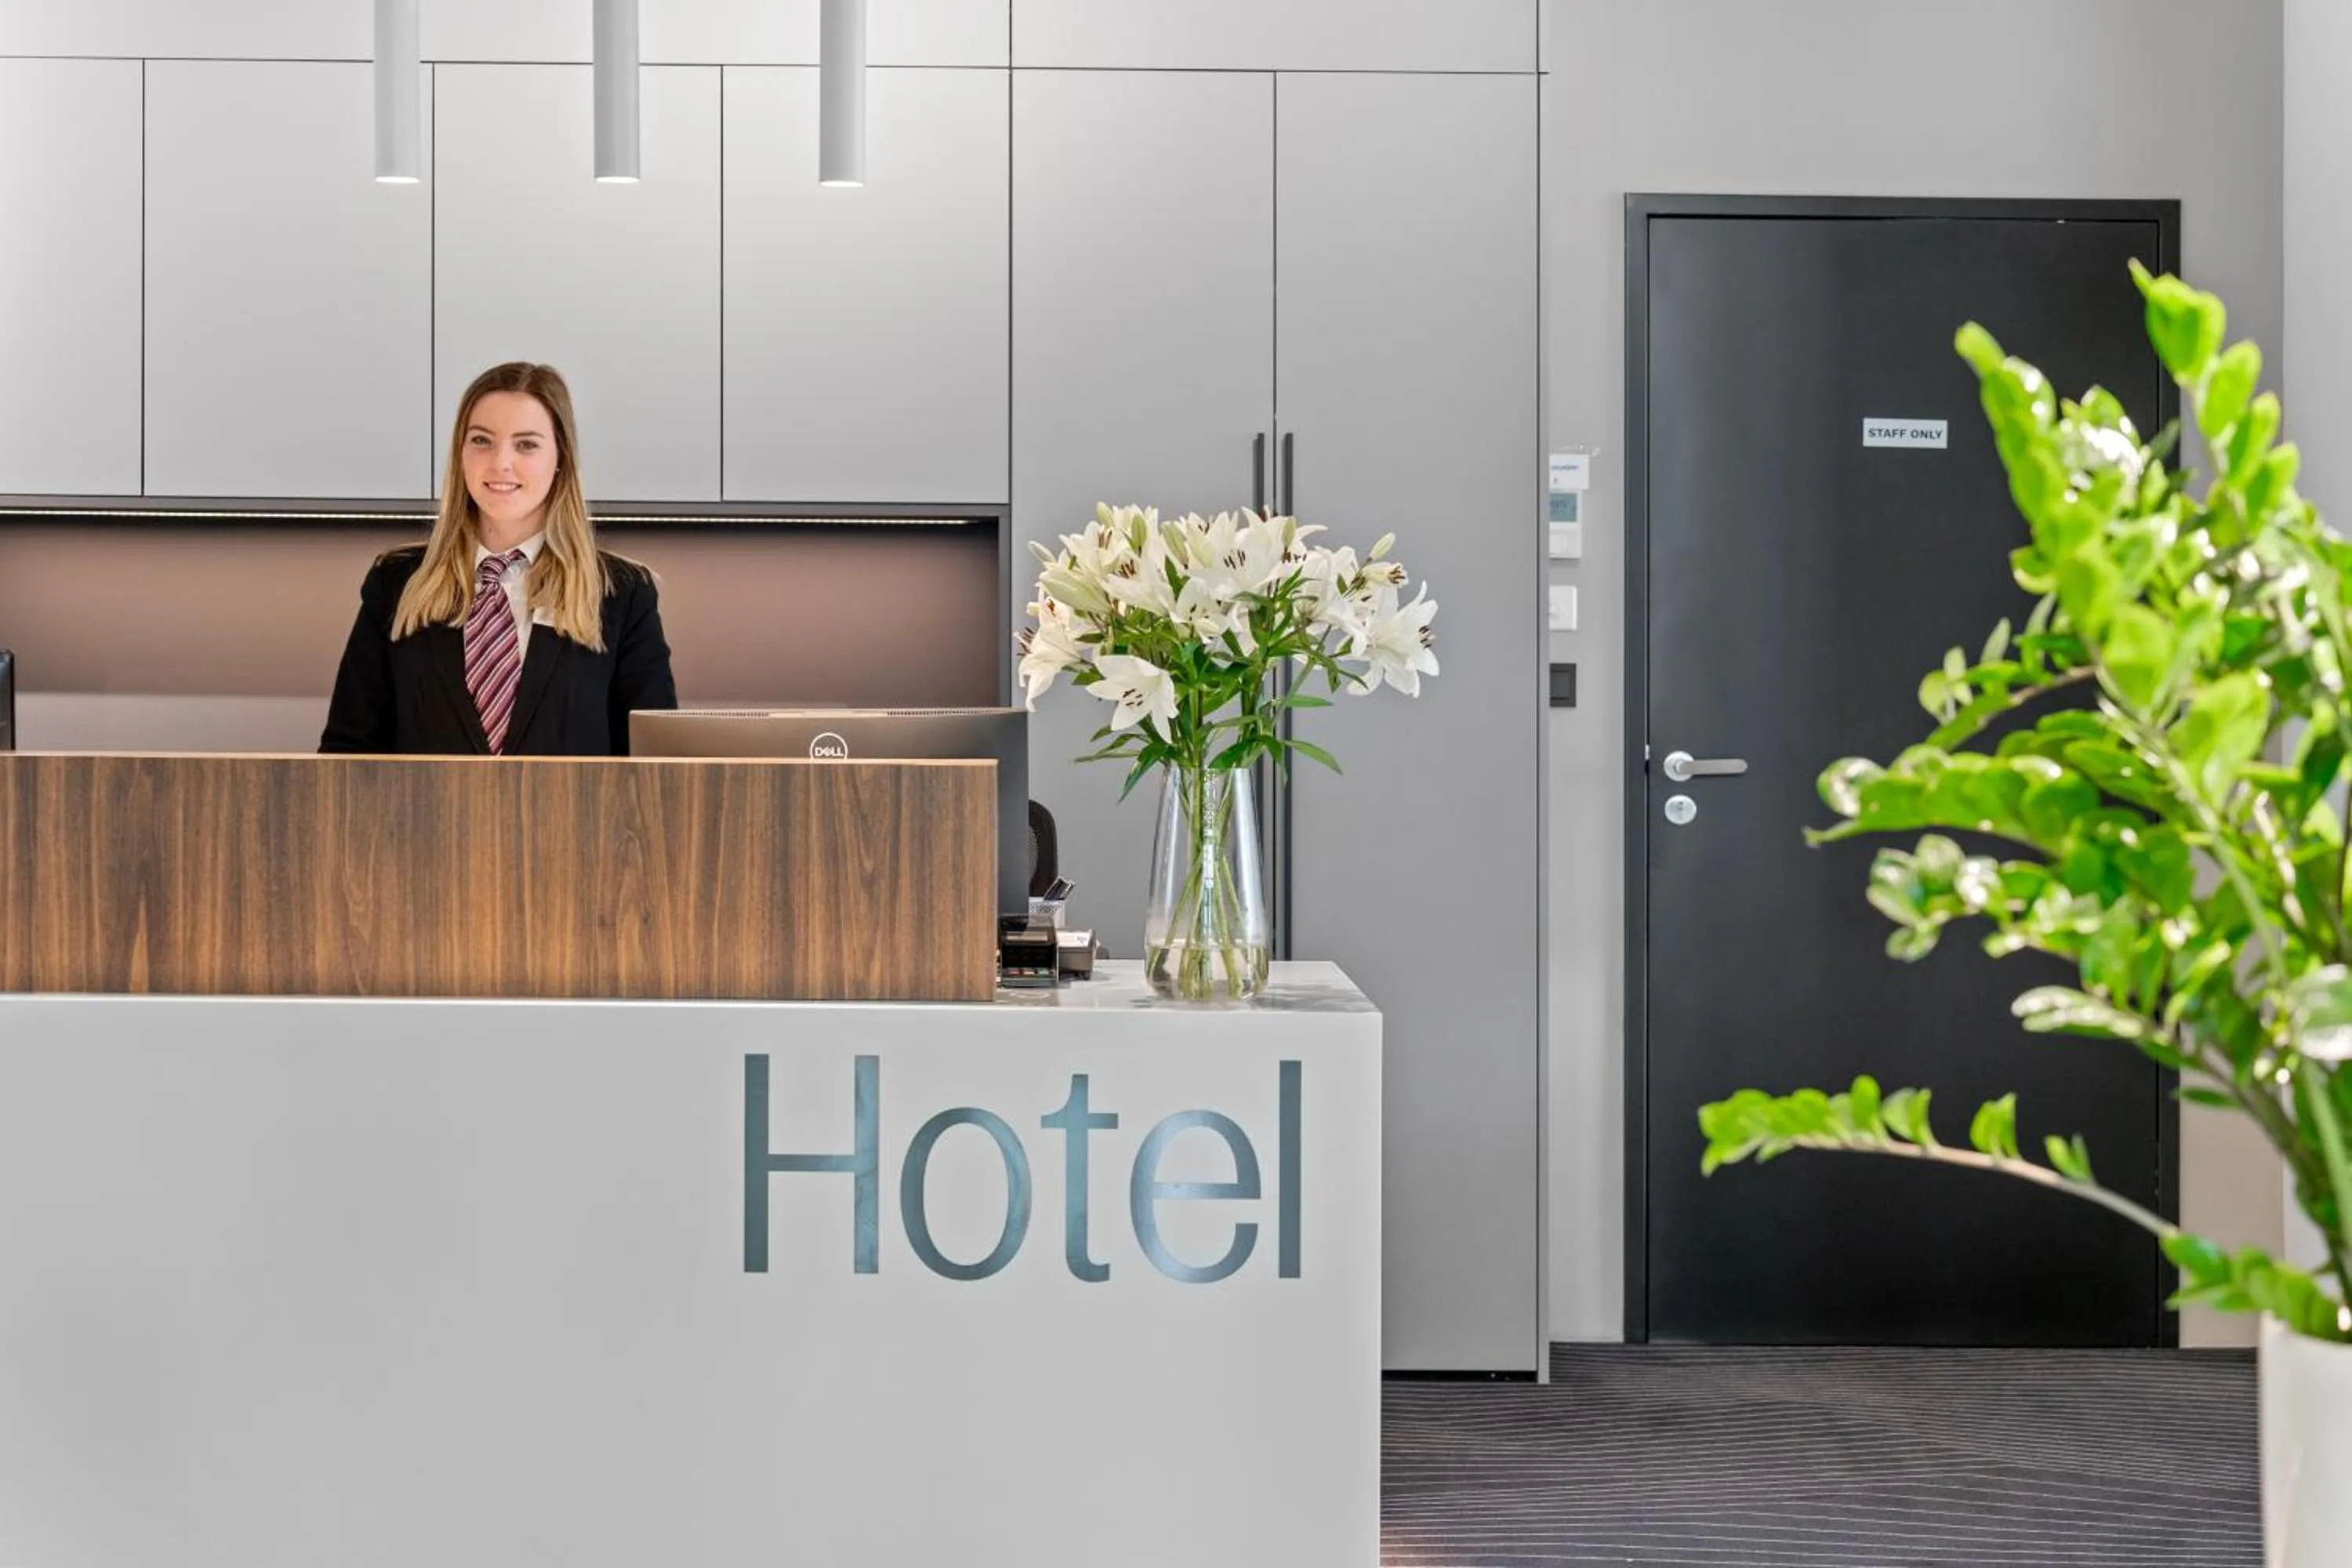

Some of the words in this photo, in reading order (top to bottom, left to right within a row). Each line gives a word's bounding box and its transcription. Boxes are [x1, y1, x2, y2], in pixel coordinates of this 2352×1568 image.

[1868, 427, 1907, 438] STAFF
[1910, 428, 1943, 440] ONLY
[815, 746, 844, 757] DELL
[744, 1053, 1302, 1284] Hotel
